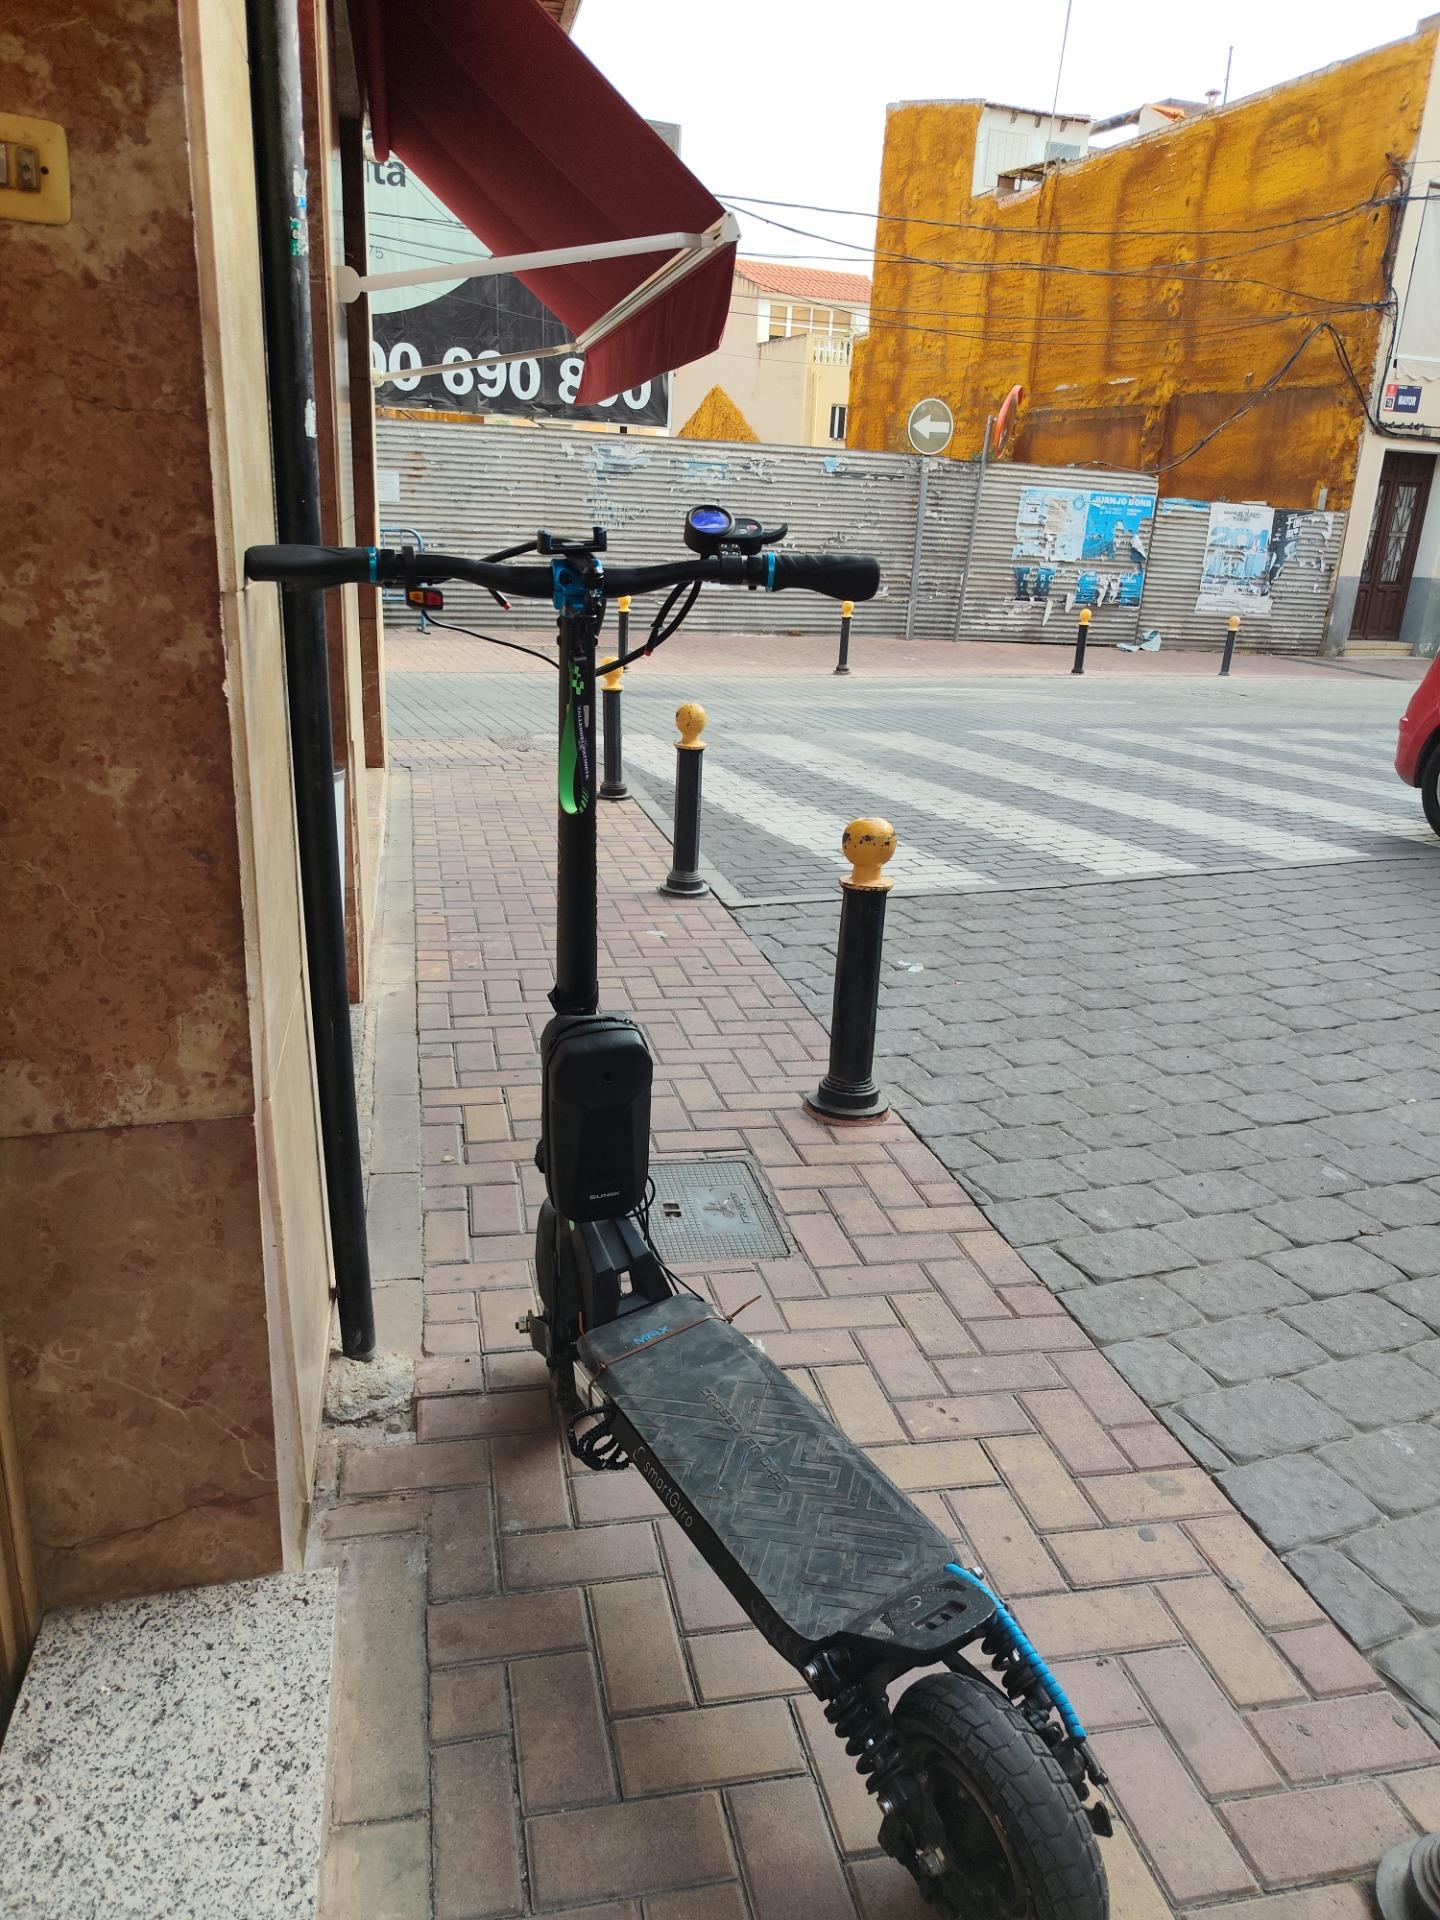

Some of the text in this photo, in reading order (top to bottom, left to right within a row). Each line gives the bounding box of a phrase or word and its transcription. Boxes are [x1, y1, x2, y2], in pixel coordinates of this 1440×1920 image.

[441, 347, 541, 400] 690
[700, 1385, 763, 1456] CROSSOVER
[643, 1462, 693, 1528] smartGyro
